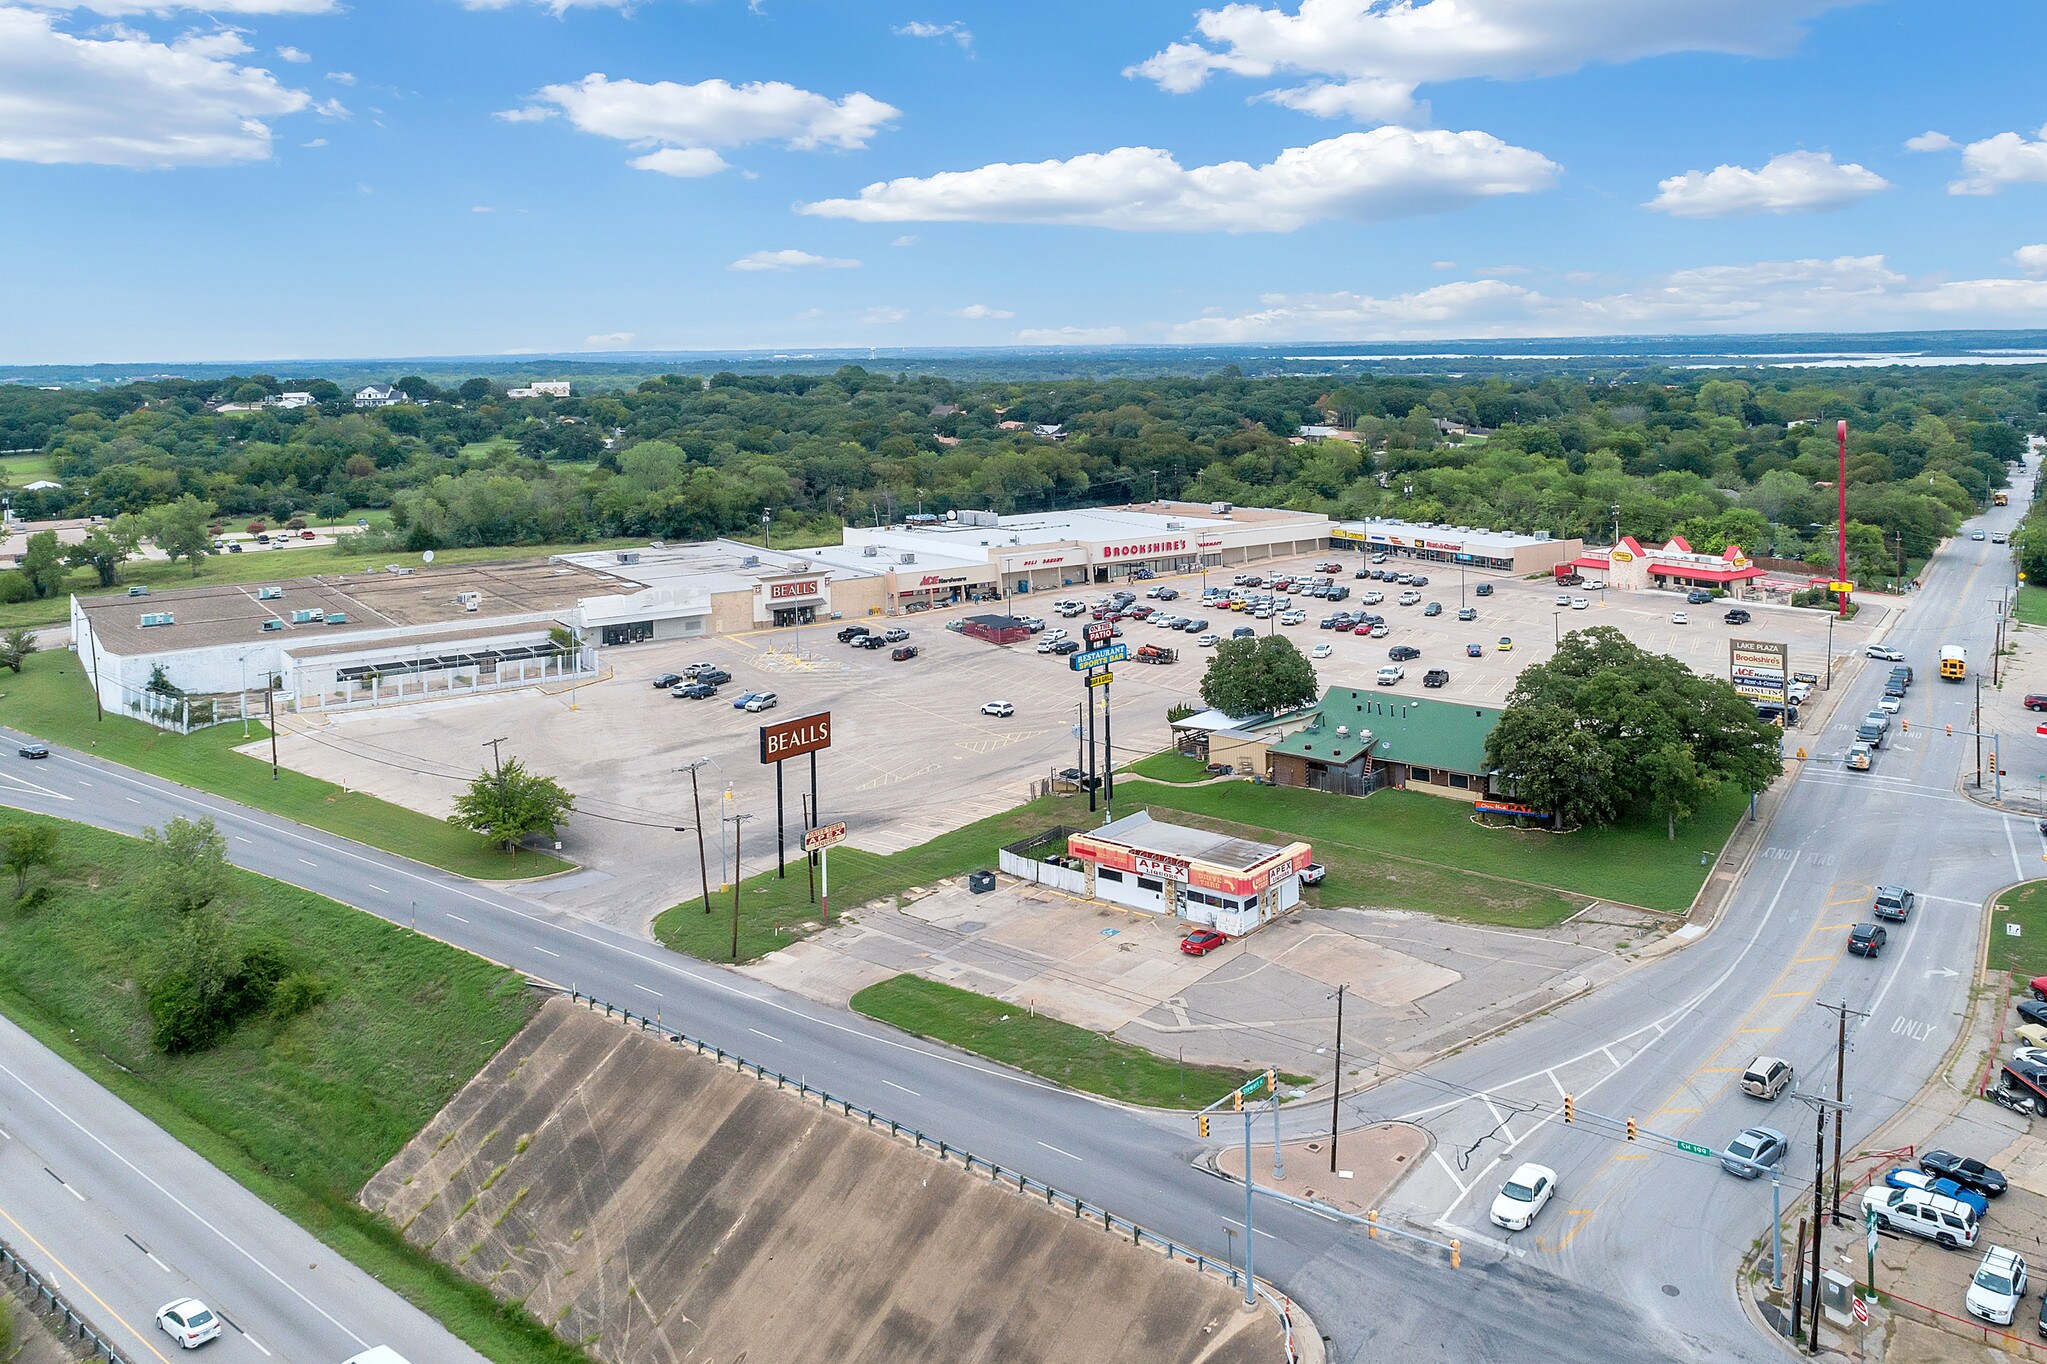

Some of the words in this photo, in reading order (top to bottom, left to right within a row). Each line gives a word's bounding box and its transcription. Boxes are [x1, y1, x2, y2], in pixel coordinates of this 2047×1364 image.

[1104, 540, 1186, 558] BROOKSHIRE'S
[920, 576, 939, 586] ACE
[773, 582, 816, 597] BEALLS
[1090, 630, 1111, 640] PATIO
[1756, 644, 1779, 652] PLAZA
[1077, 646, 1125, 663] RESTAURANT
[1736, 654, 1780, 664] Brookshire's
[1079, 656, 1107, 669] SPORTS
[1110, 653, 1124, 662] BAR
[1735, 667, 1754, 676] ACE
[1744, 679, 1782, 687] Rent-A-Center
[1741, 687, 1778, 695] DONUTS
[768, 722, 828, 754] BEALLS
[810, 830, 842, 844] APEX
[814, 836, 837, 847] LIQUOR
[1761, 847, 1793, 860] ONLY
[1139, 860, 1184, 876] APEX
[1271, 862, 1291, 878] APEX
[1146, 869, 1178, 880] LIQUORS
[1198, 874, 1222, 884] DRIVE
[1200, 880, 1221, 889] THRU
[1890, 1016, 1936, 1041] ONLY
